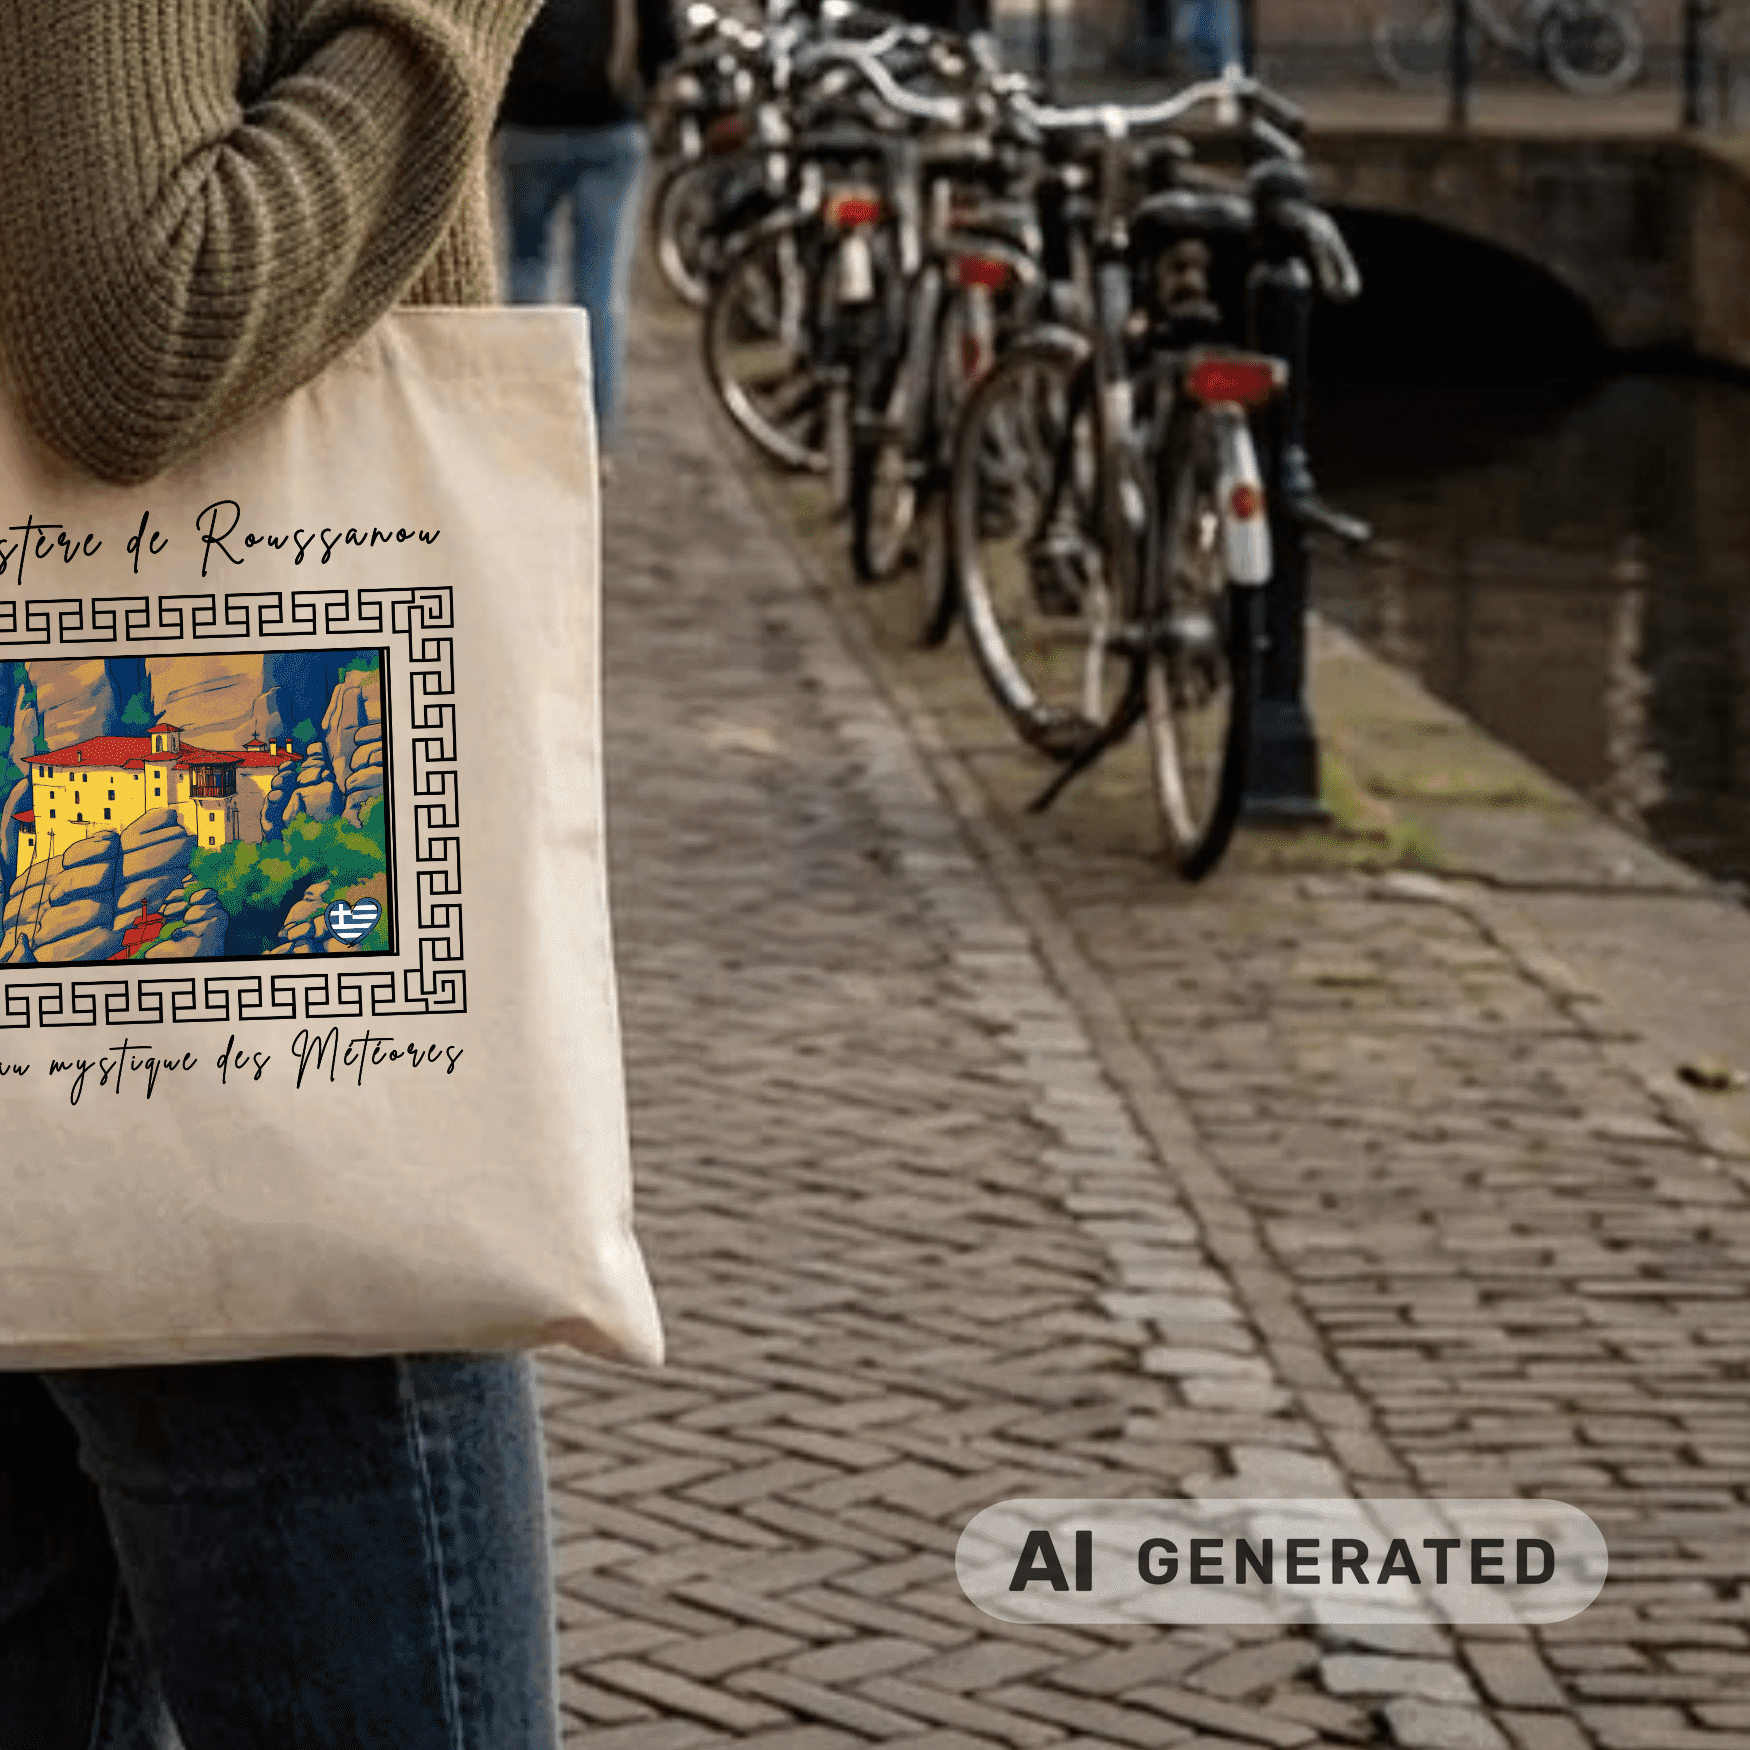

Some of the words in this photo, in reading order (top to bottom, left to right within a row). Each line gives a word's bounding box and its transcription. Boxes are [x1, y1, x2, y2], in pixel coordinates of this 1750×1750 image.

[126, 510, 169, 575] de
[195, 499, 441, 578] Roussanou
[49, 1037, 198, 1106] mystique
[216, 1034, 271, 1085] des
[291, 1026, 464, 1090] Météores
